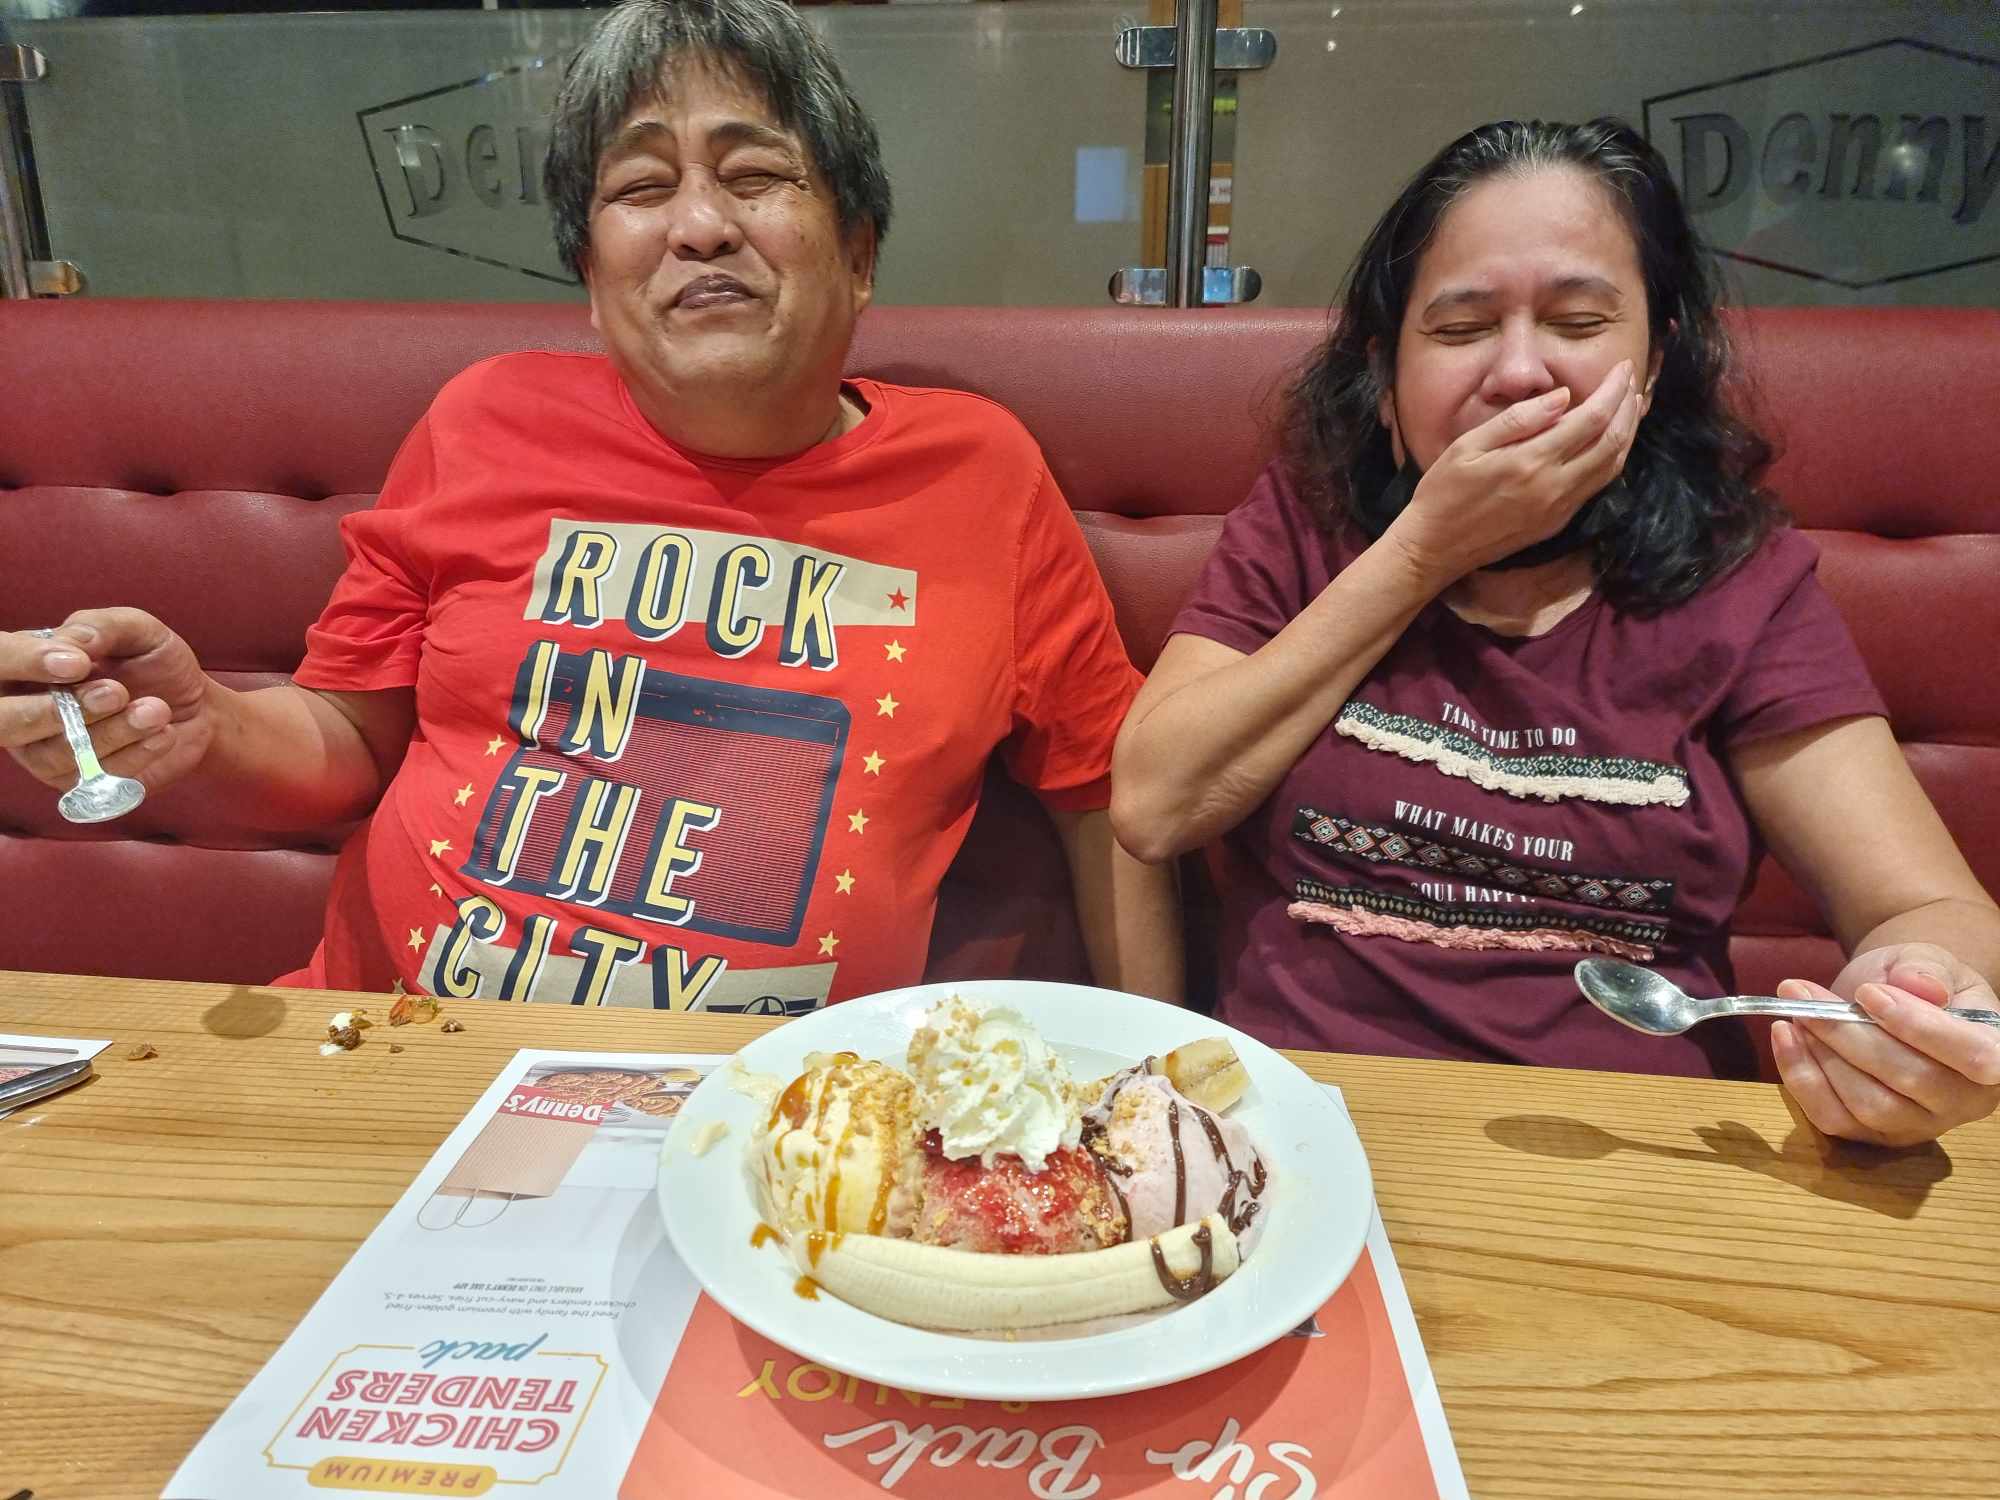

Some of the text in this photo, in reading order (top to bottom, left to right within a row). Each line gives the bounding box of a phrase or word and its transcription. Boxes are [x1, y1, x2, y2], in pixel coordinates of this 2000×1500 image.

[542, 529, 847, 671] ROCK
[508, 640, 647, 762] IN
[1442, 702, 1576, 749] TAKE TIME TO DO
[484, 765, 722, 924] THE
[1394, 800, 1574, 862] WHAT MAKES YOUR
[434, 895, 728, 1011] CITY
[504, 1095, 602, 1121] Denny's
[457, 1304, 508, 1314] premium
[510, 1306, 532, 1316] with
[527, 1297, 548, 1306] and
[536, 1307, 568, 1319] family
[551, 1297, 593, 1309] tenders
[571, 1309, 590, 1318] the
[594, 1299, 637, 1310] chicken
[418, 1332, 549, 1369] pack
[326, 1369, 579, 1413] TENDERS
[296, 1406, 561, 1453] CHICKEN
[323, 1462, 482, 1490] PREMIUM
[823, 1417, 1318, 1500] Sip Back
